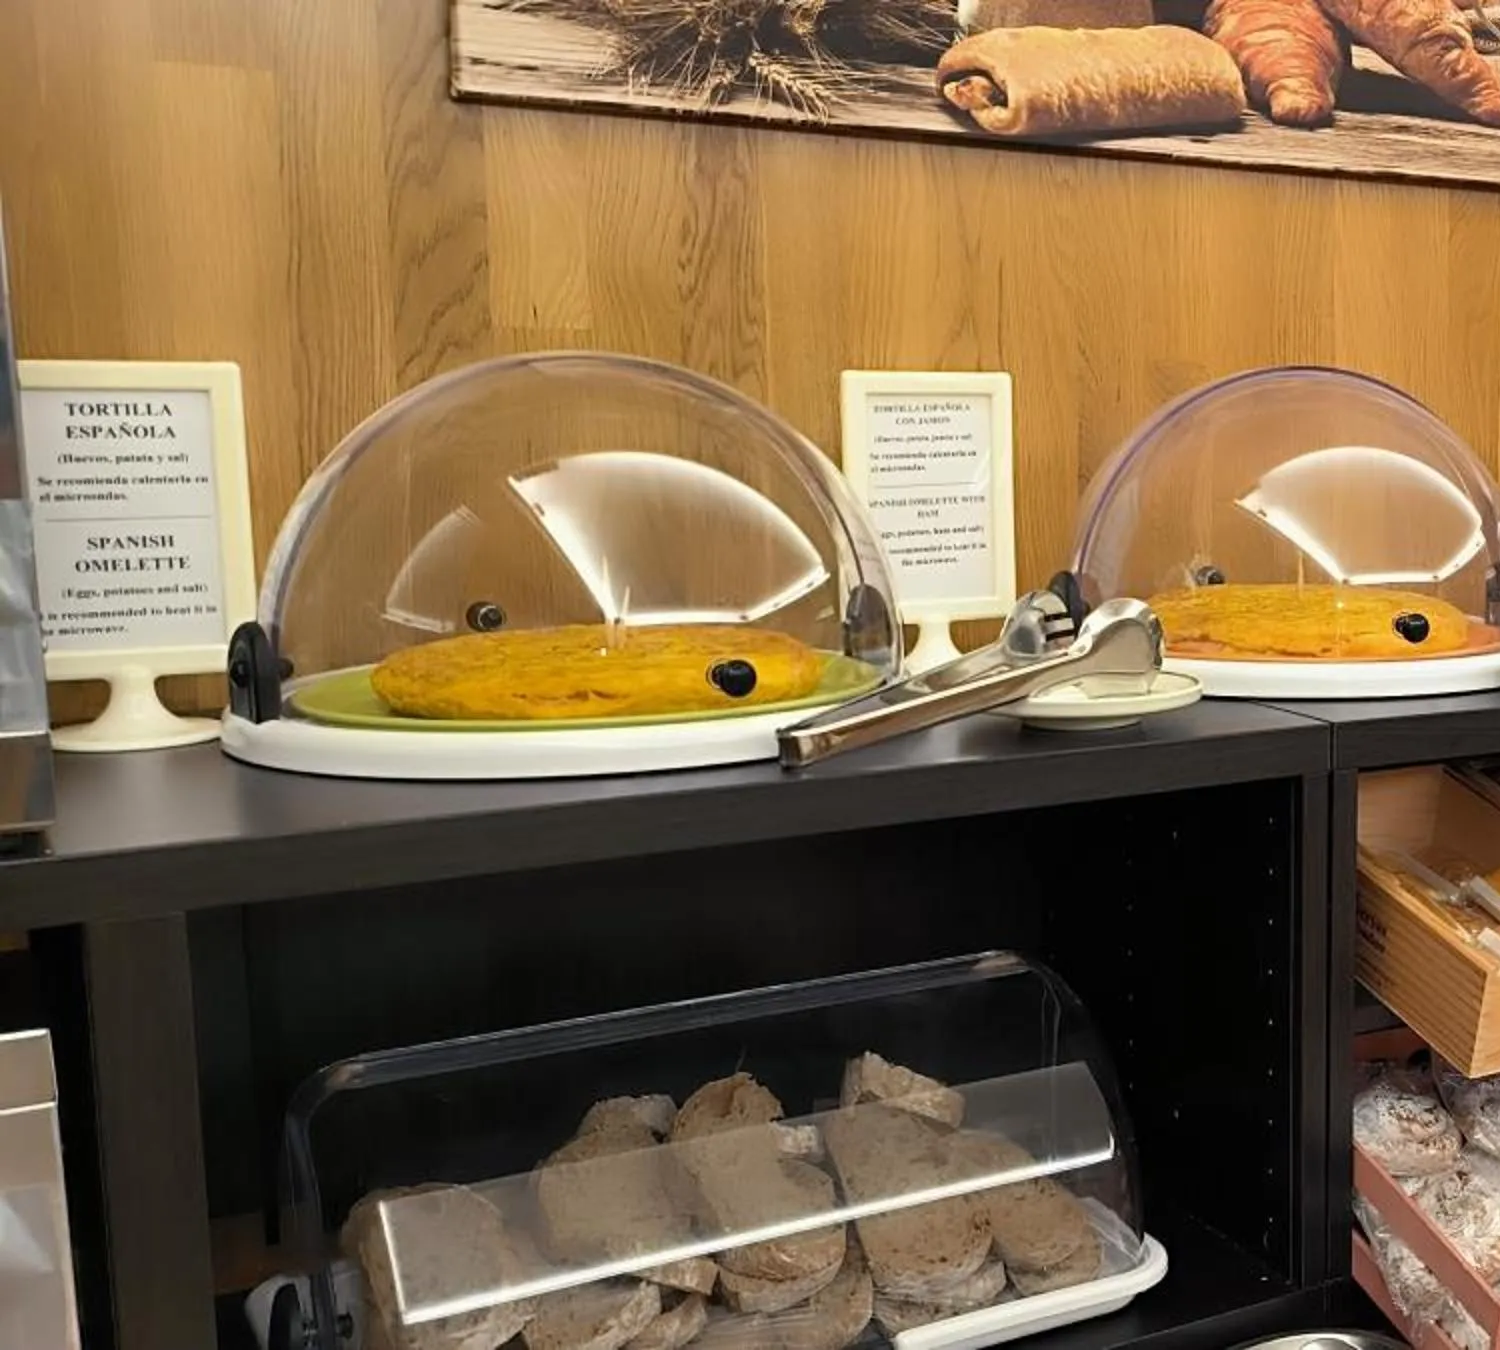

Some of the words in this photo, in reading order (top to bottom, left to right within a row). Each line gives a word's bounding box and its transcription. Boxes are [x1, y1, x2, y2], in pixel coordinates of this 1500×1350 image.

[64, 402, 172, 417] TORTILLA
[66, 422, 176, 439] ESPAÑOLA
[115, 453, 154, 465] patata
[158, 455, 164, 464] y
[37, 476, 52, 486] Se
[57, 475, 128, 486] recomienda
[131, 475, 191, 485] calentarla
[195, 476, 209, 484] en
[87, 535, 175, 551] SPANISH
[75, 556, 191, 573] OMELETTE
[103, 586, 154, 598] potatoes
[157, 584, 179, 594] and
[61, 607, 147, 621] recommended
[151, 607, 162, 616] to
[165, 606, 191, 616] heat
